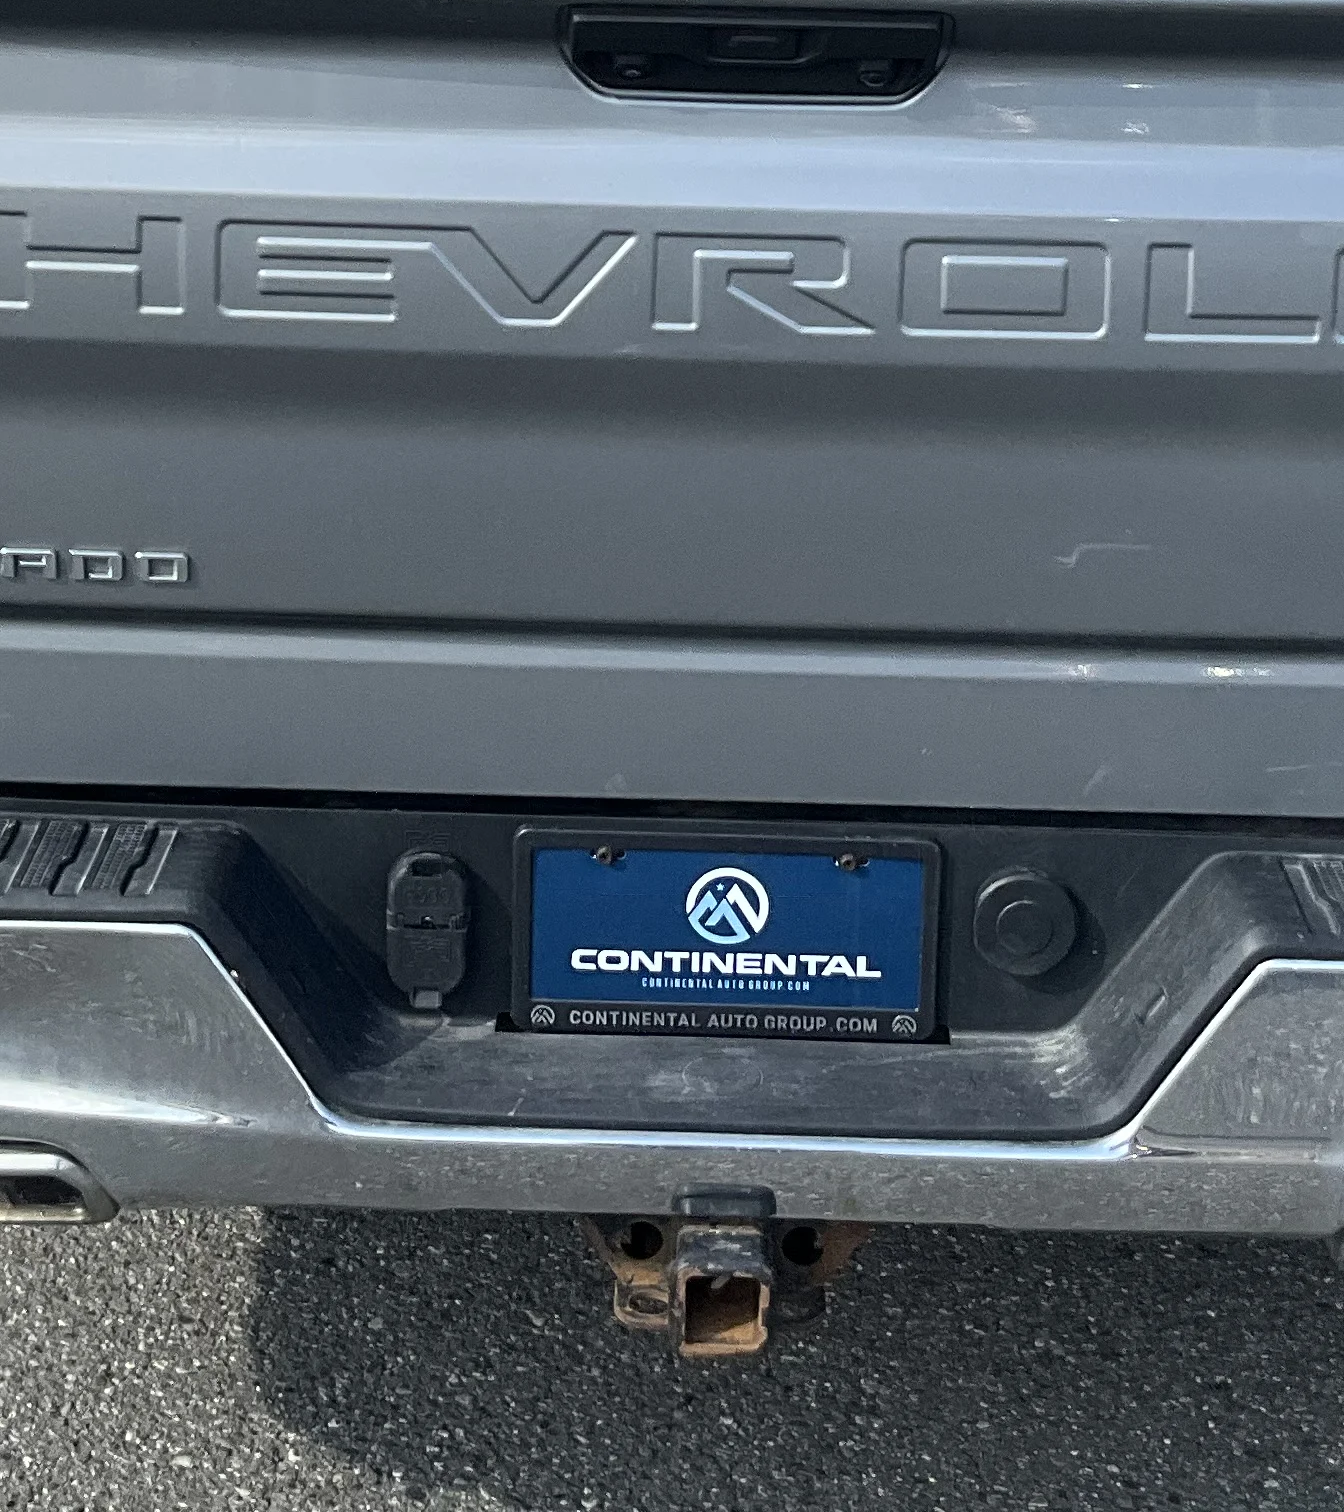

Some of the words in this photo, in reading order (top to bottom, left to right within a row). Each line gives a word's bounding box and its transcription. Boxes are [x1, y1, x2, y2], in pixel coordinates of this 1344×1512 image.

[570, 948, 883, 978] CONTINENTAL
[641, 976, 713, 990] CONTINENTAL
[716, 978, 745, 990] AUTO
[569, 1009, 701, 1028] CONTINENTAL
[707, 1012, 758, 1029] AUTO
